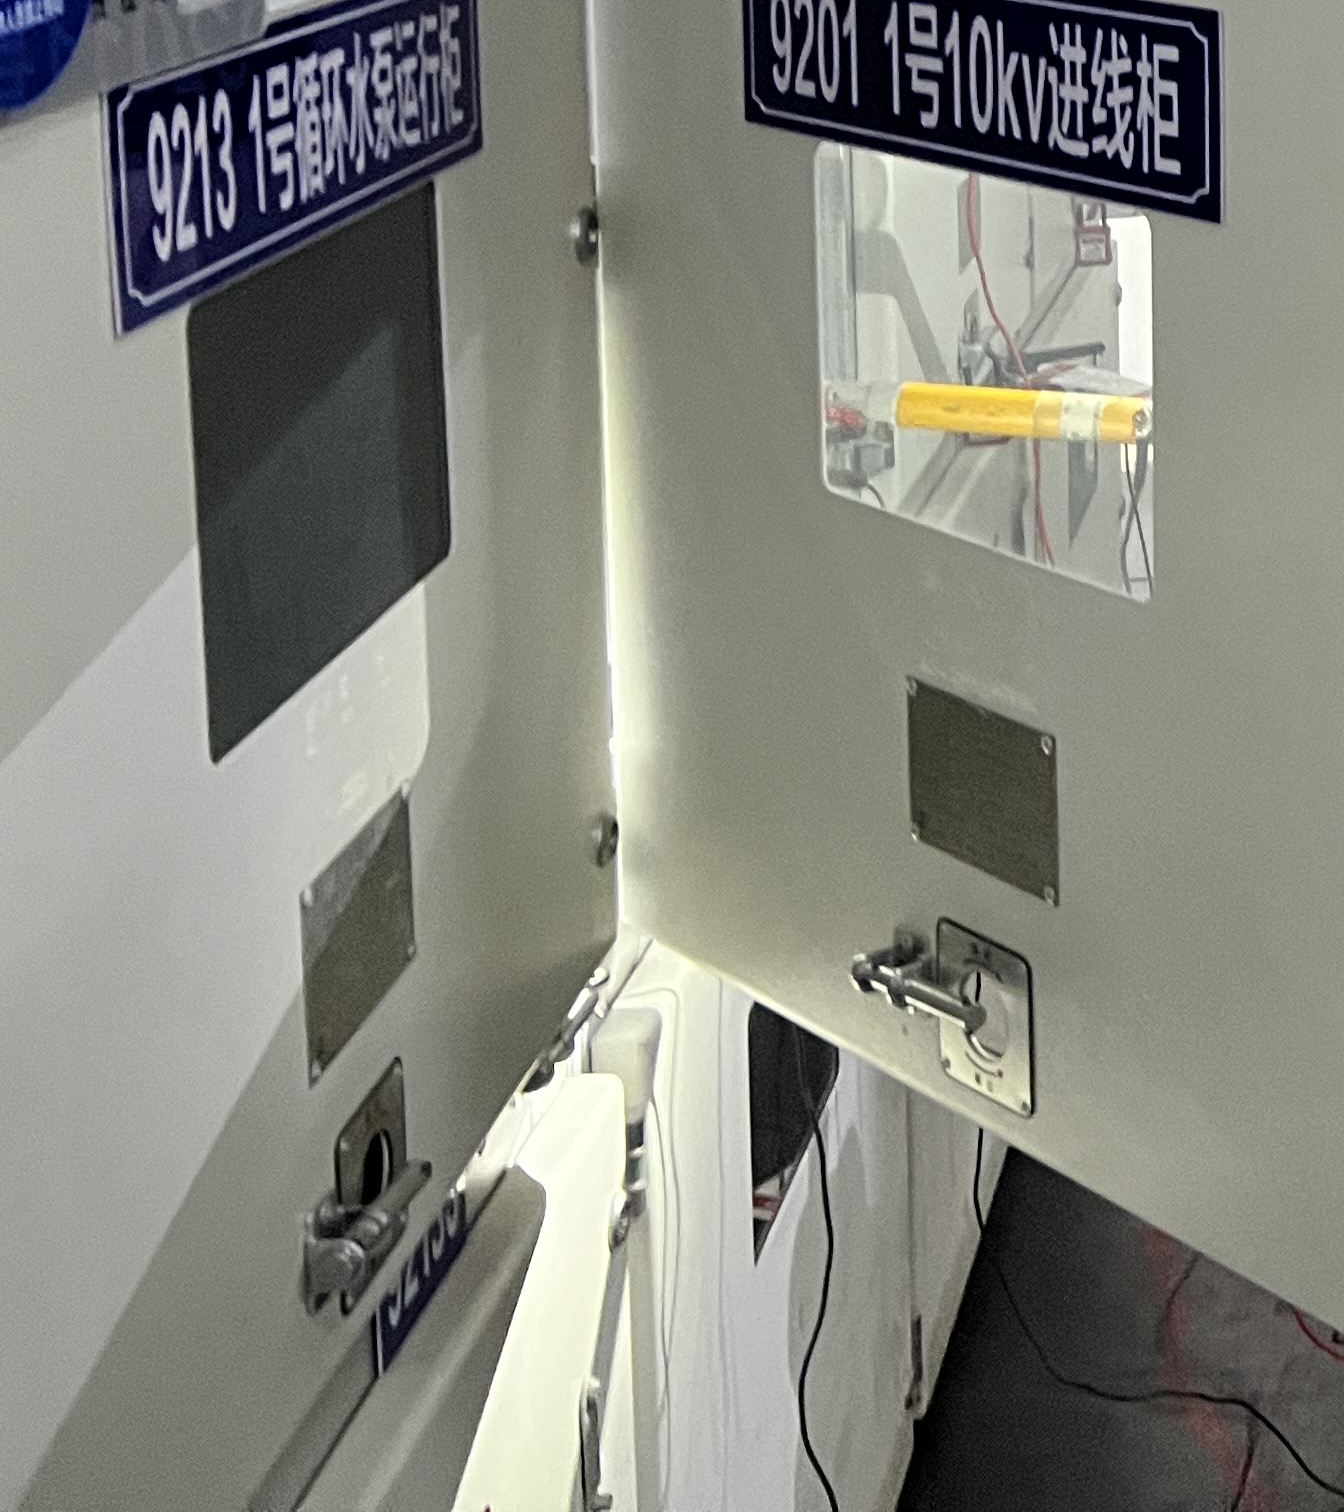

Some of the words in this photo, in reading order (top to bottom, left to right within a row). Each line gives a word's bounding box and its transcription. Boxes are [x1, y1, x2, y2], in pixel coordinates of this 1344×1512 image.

[146, 88, 236, 262] 9213
[247, 2, 465, 214] 1号循环水泵运行柜
[883, 0, 1182, 176] 1号10kv进线柜
